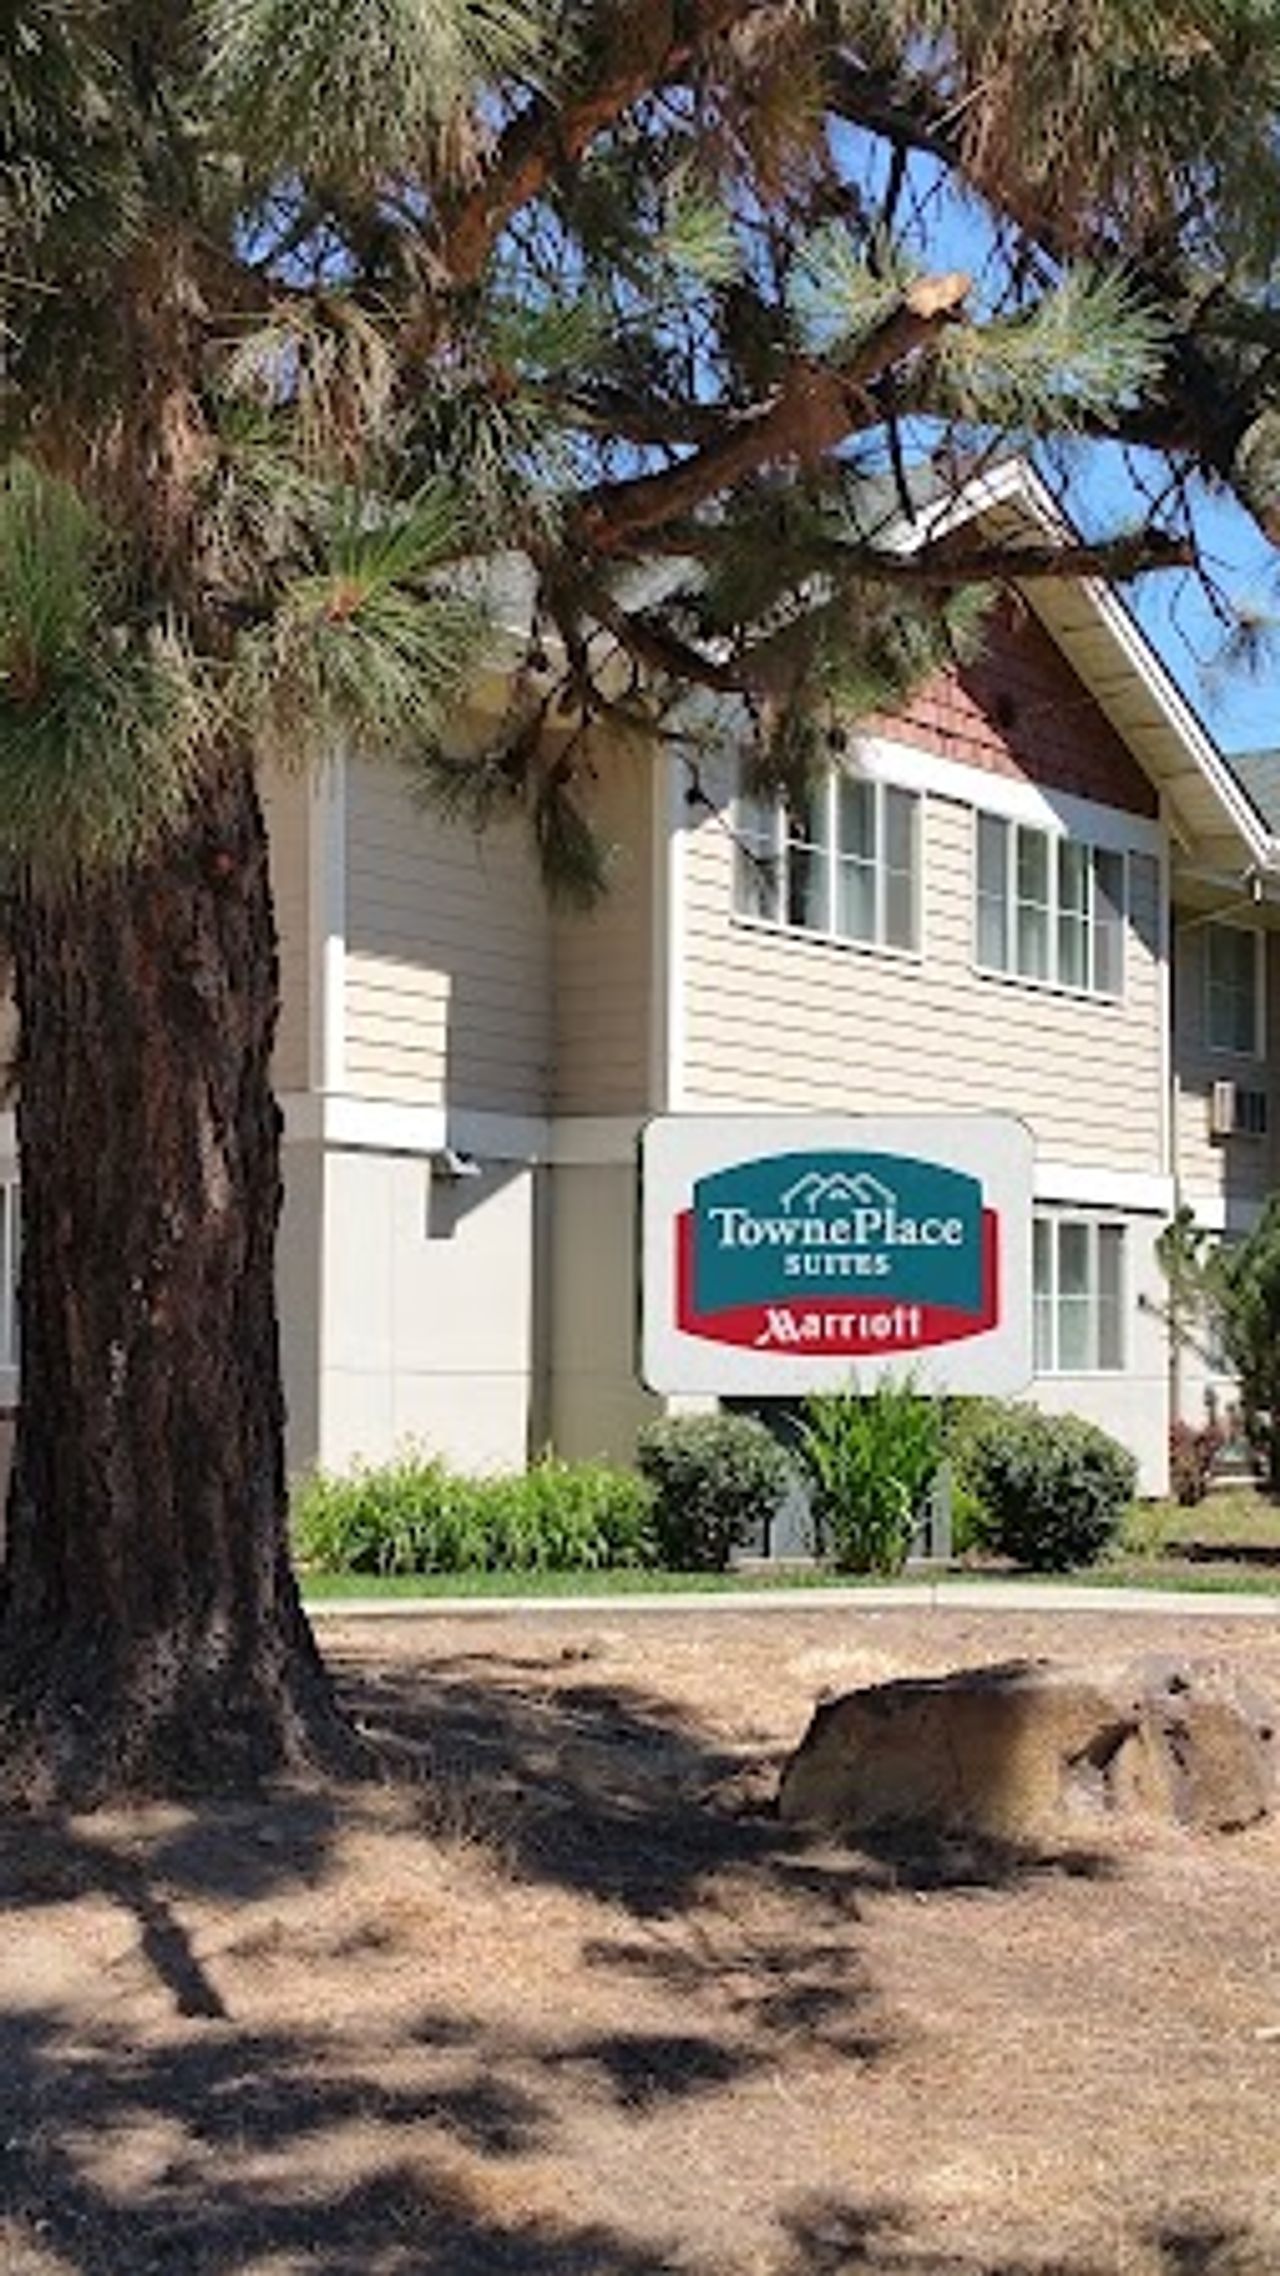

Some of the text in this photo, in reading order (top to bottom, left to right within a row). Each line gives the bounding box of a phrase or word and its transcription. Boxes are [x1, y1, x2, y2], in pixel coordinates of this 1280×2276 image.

[709, 1206, 963, 1246] TownePlace
[784, 1253, 890, 1276] SUITES
[755, 1307, 922, 1345] Marriott
